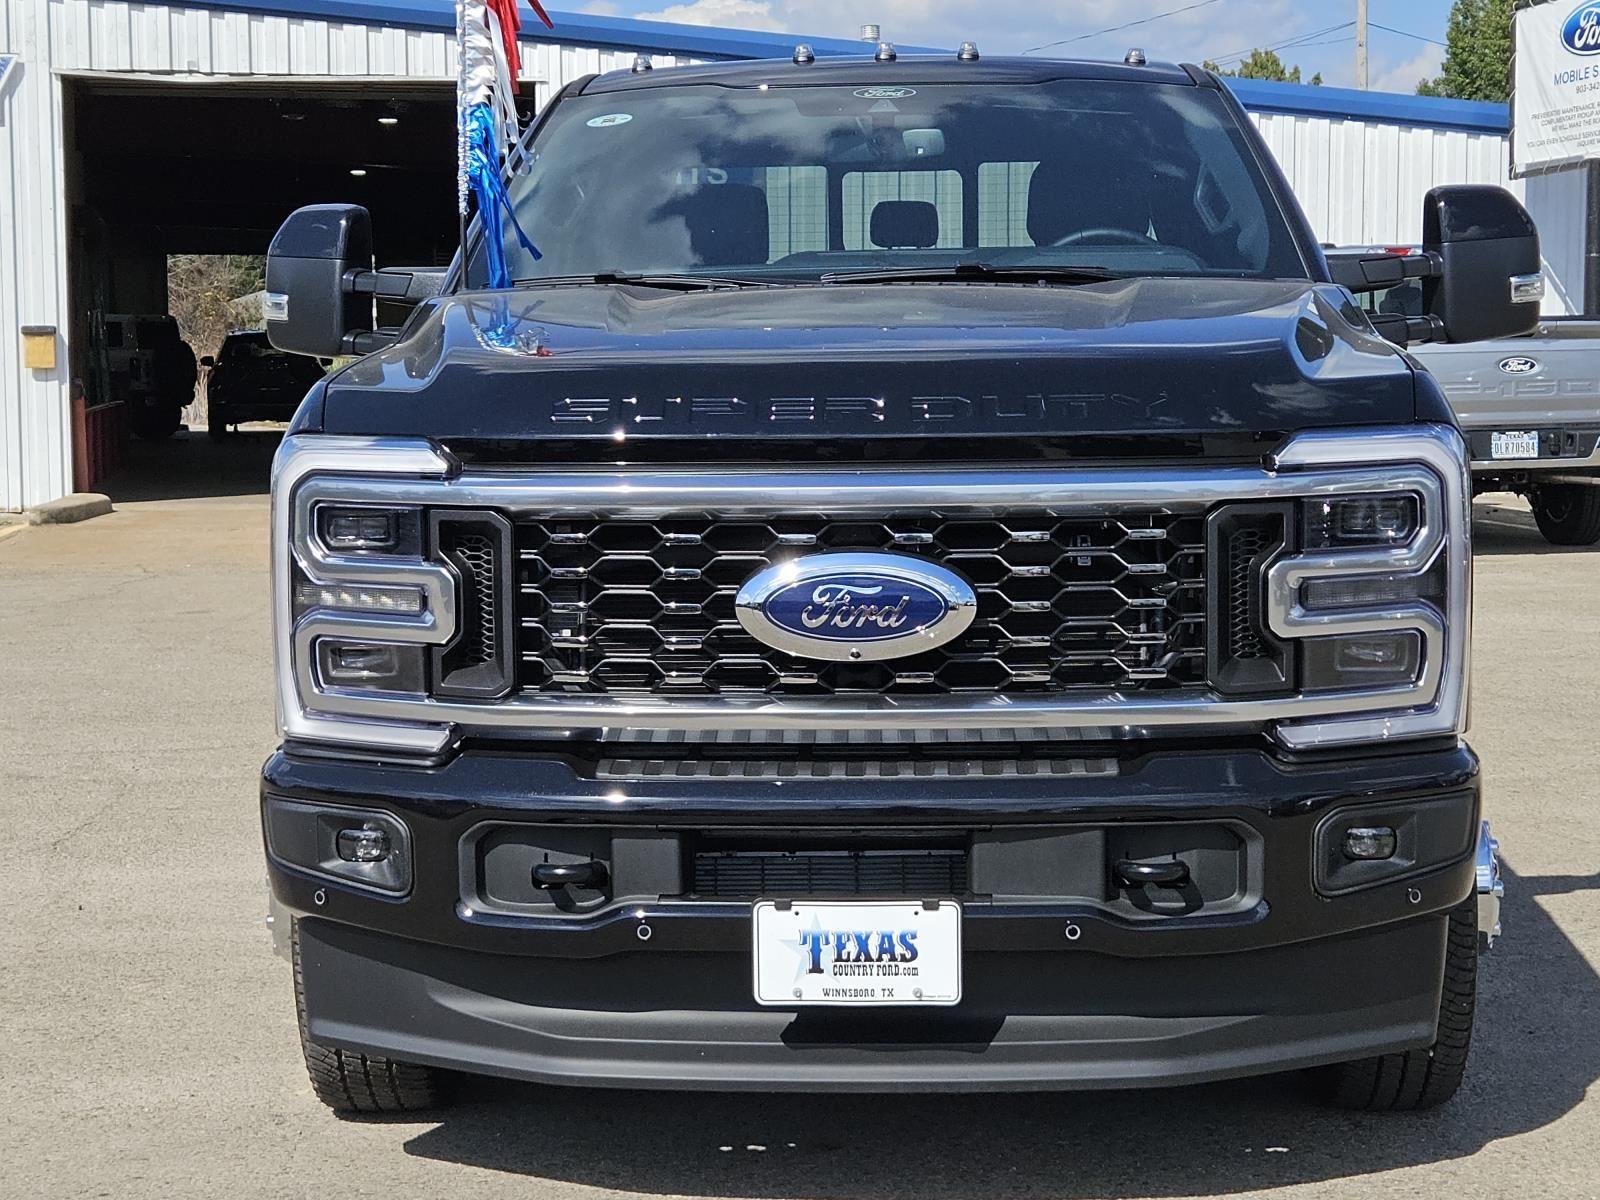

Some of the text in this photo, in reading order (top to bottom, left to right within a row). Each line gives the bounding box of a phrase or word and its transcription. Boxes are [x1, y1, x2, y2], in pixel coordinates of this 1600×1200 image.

[1553, 66, 1590, 86] MOBILE
[864, 88, 905, 97] Ford
[1504, 359, 1531, 372] Ford
[550, 390, 1169, 425] SUPER DUTY
[801, 583, 910, 628] Ford
[799, 929, 919, 974] TEXAS
[832, 964, 874, 977] COUNTRY
[822, 987, 894, 998] WINNSBORO TX
